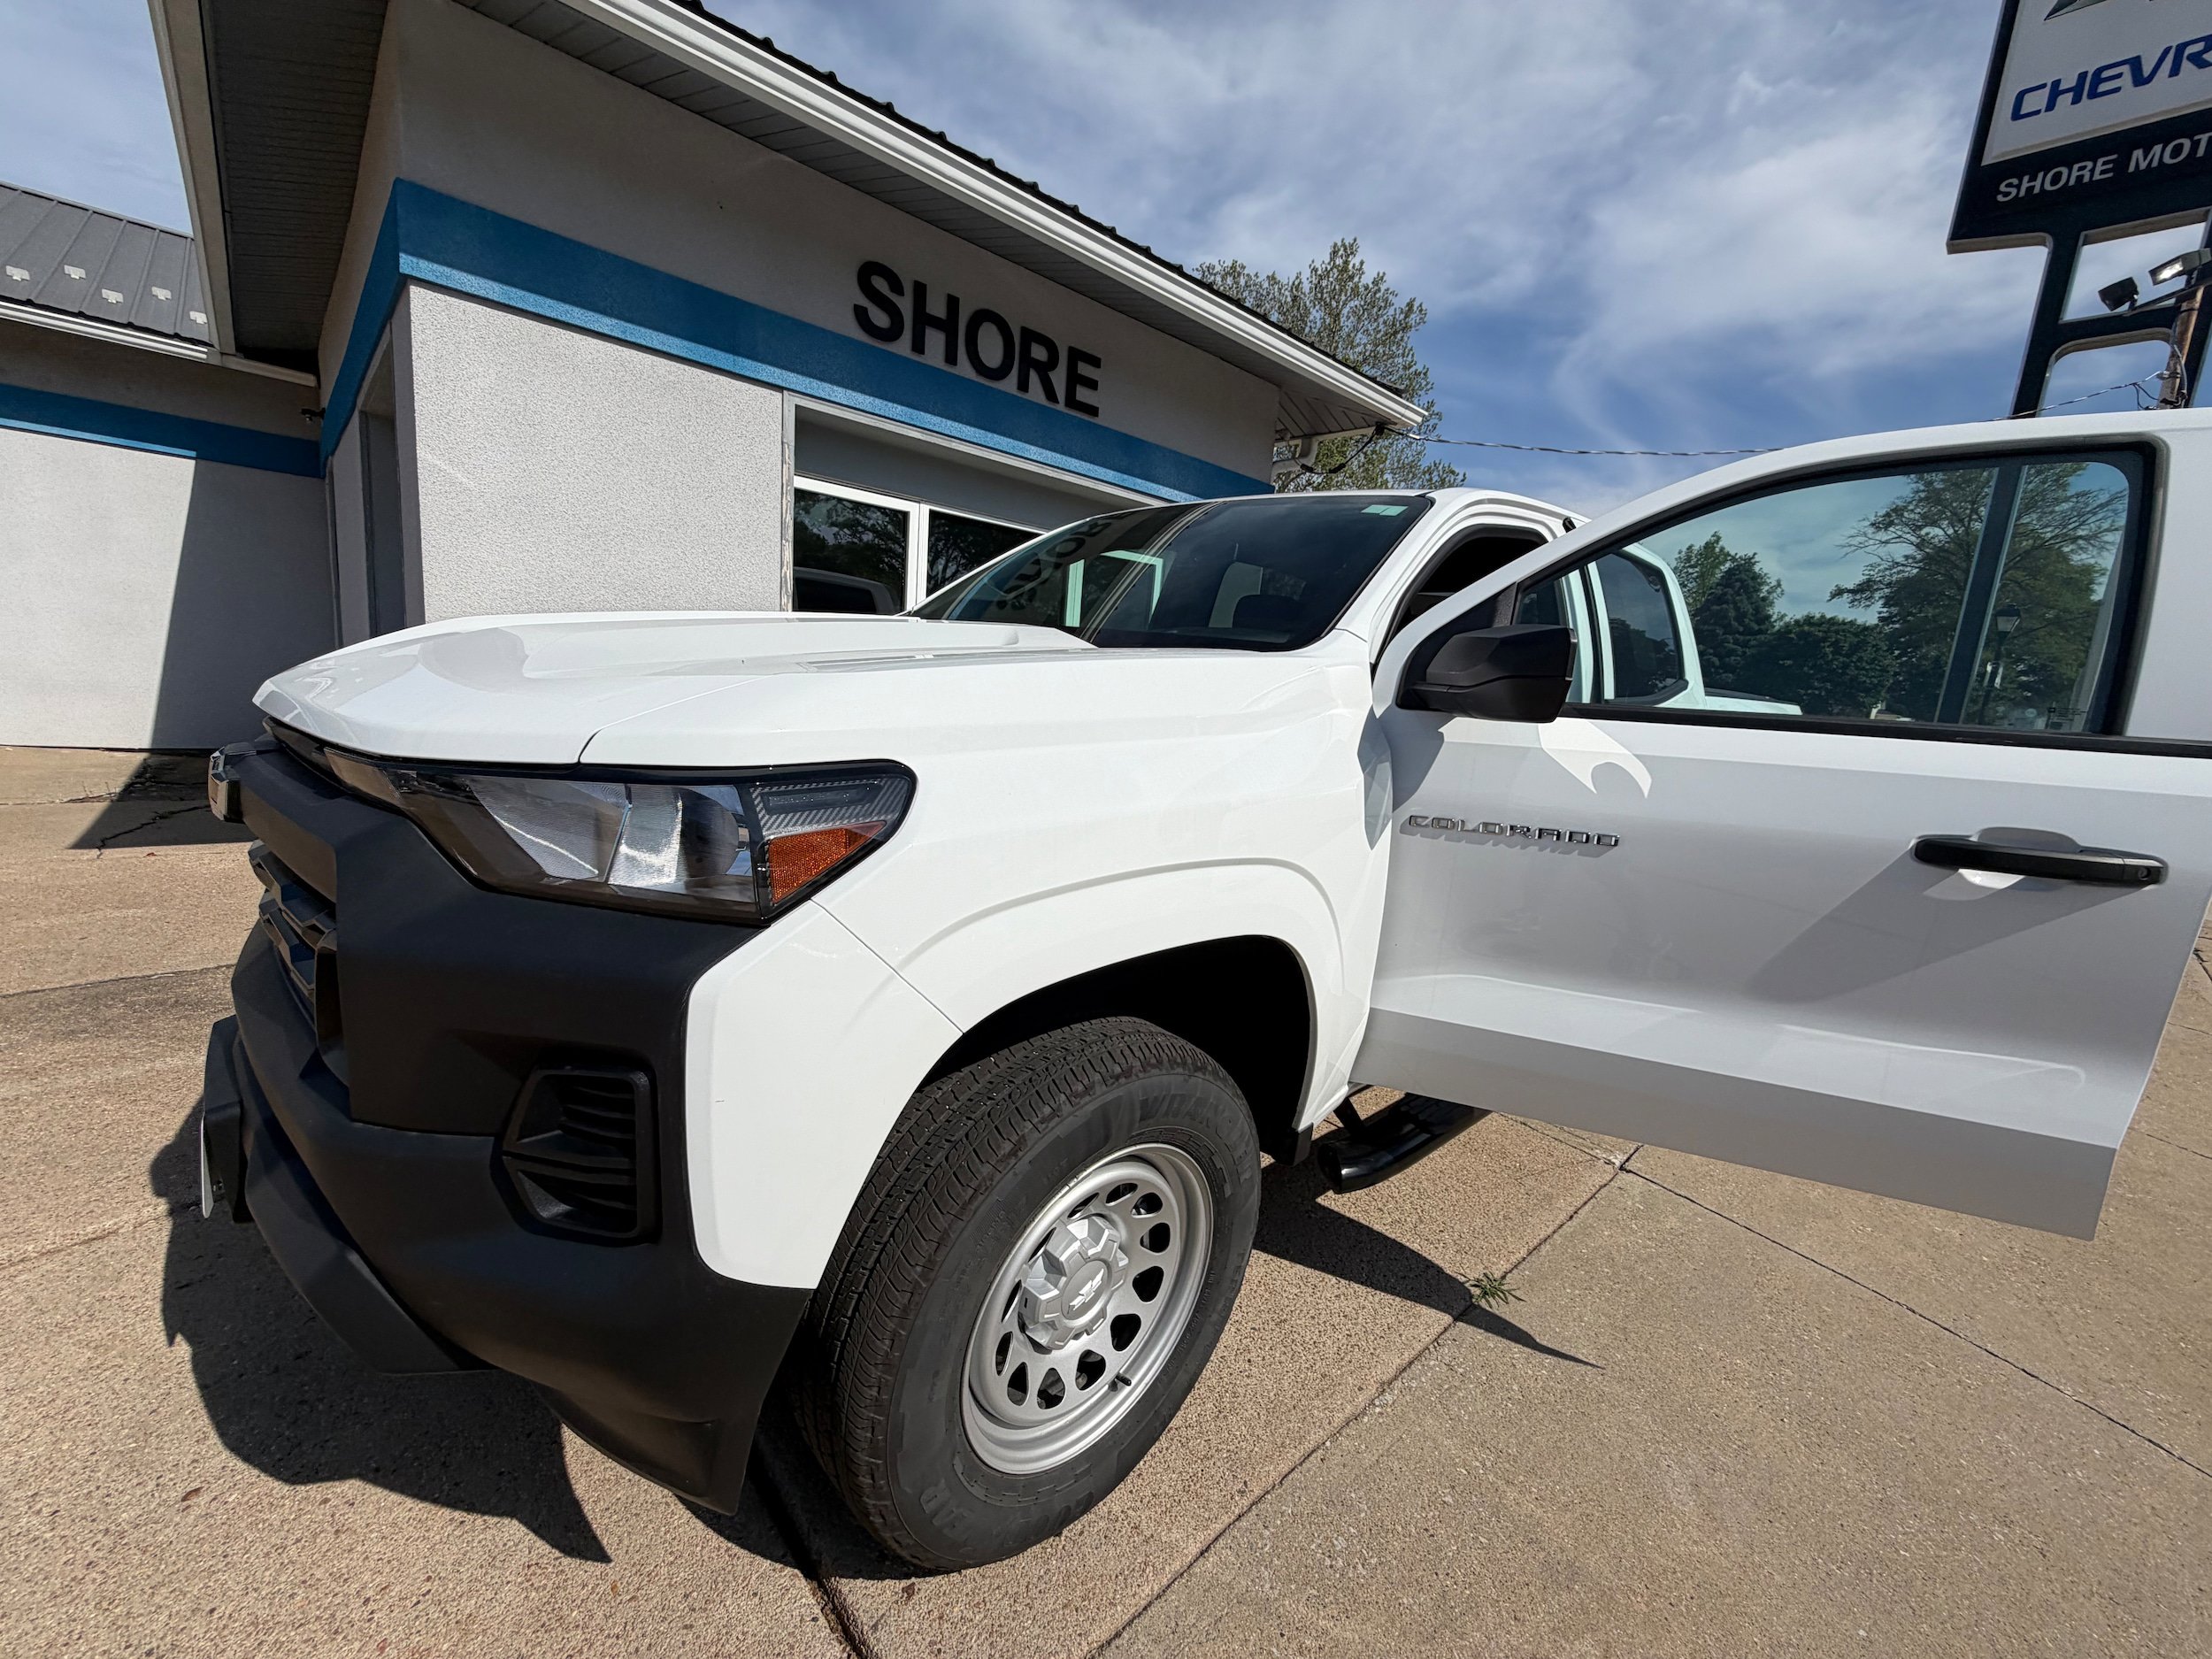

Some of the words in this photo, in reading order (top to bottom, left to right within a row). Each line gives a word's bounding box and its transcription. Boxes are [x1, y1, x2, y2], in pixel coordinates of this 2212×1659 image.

[2010, 34, 2212, 121] CHEVR
[1996, 154, 2118, 202] SHORE
[853, 260, 1102, 418] SHORE
[1409, 815, 1620, 847] COLORADO
